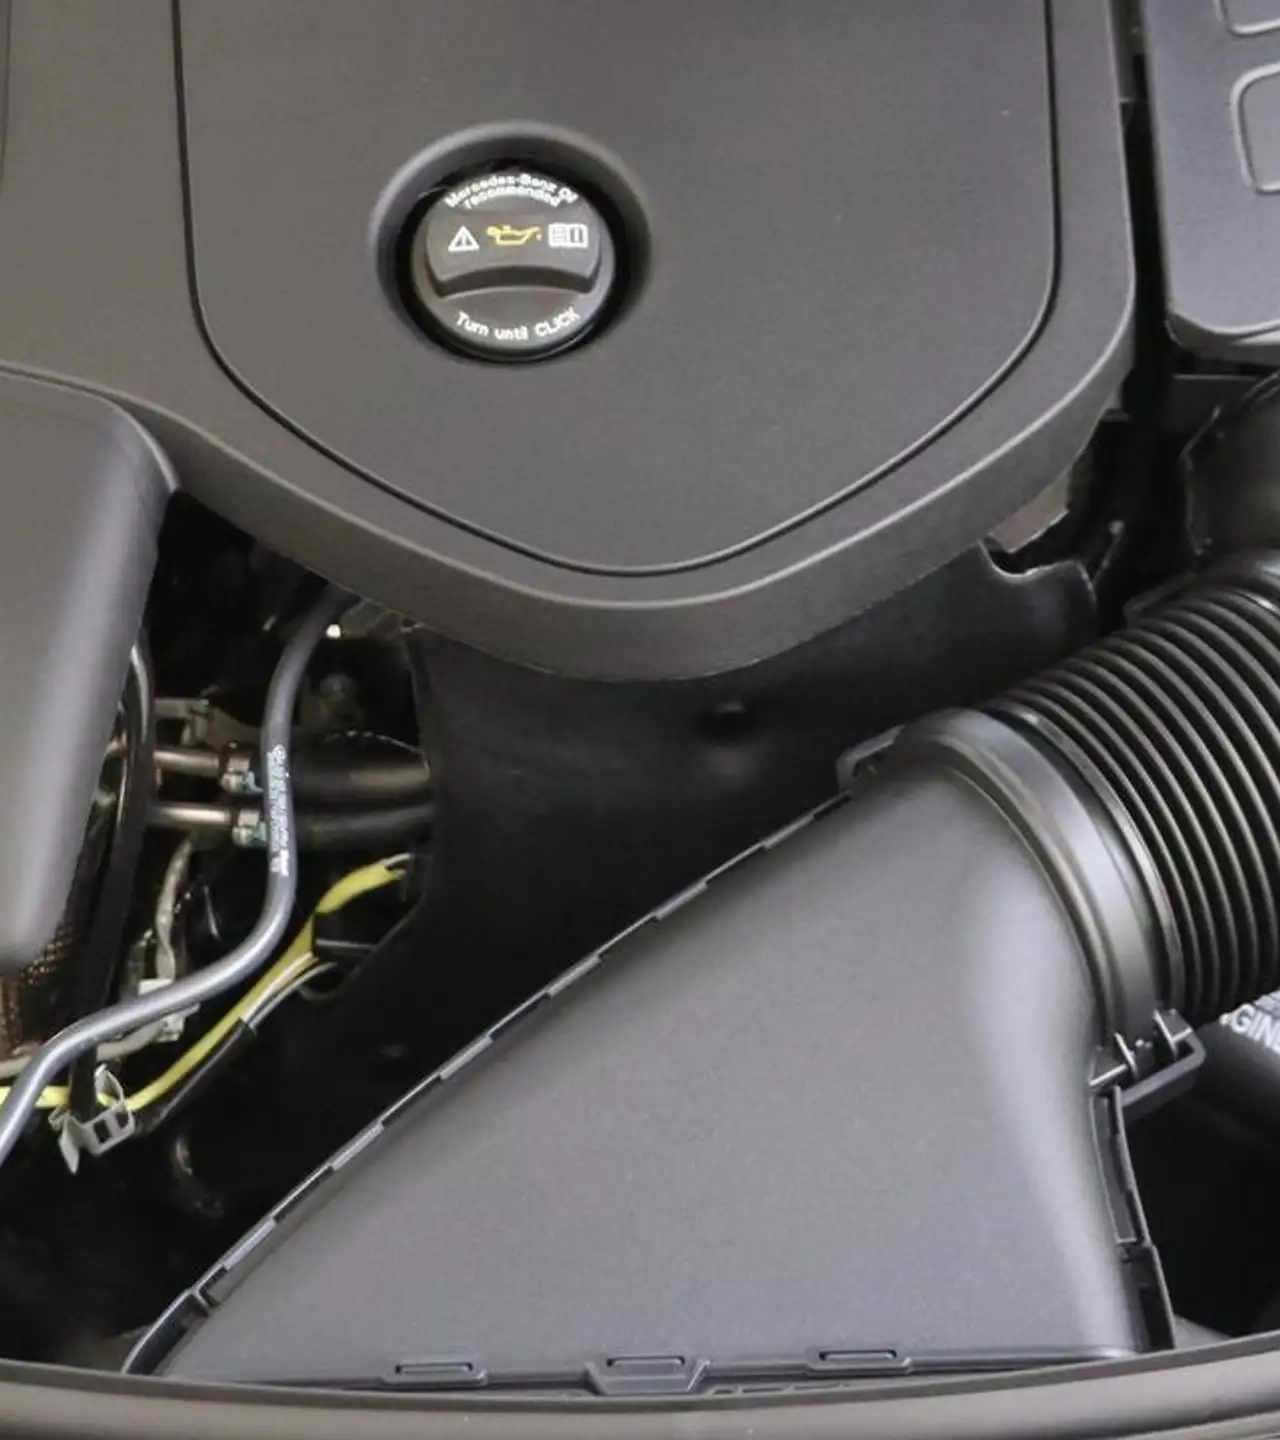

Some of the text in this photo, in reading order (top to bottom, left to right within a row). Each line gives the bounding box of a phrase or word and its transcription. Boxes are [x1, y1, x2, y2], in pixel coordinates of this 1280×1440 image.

[455, 305, 581, 341] Turn until CLICK
